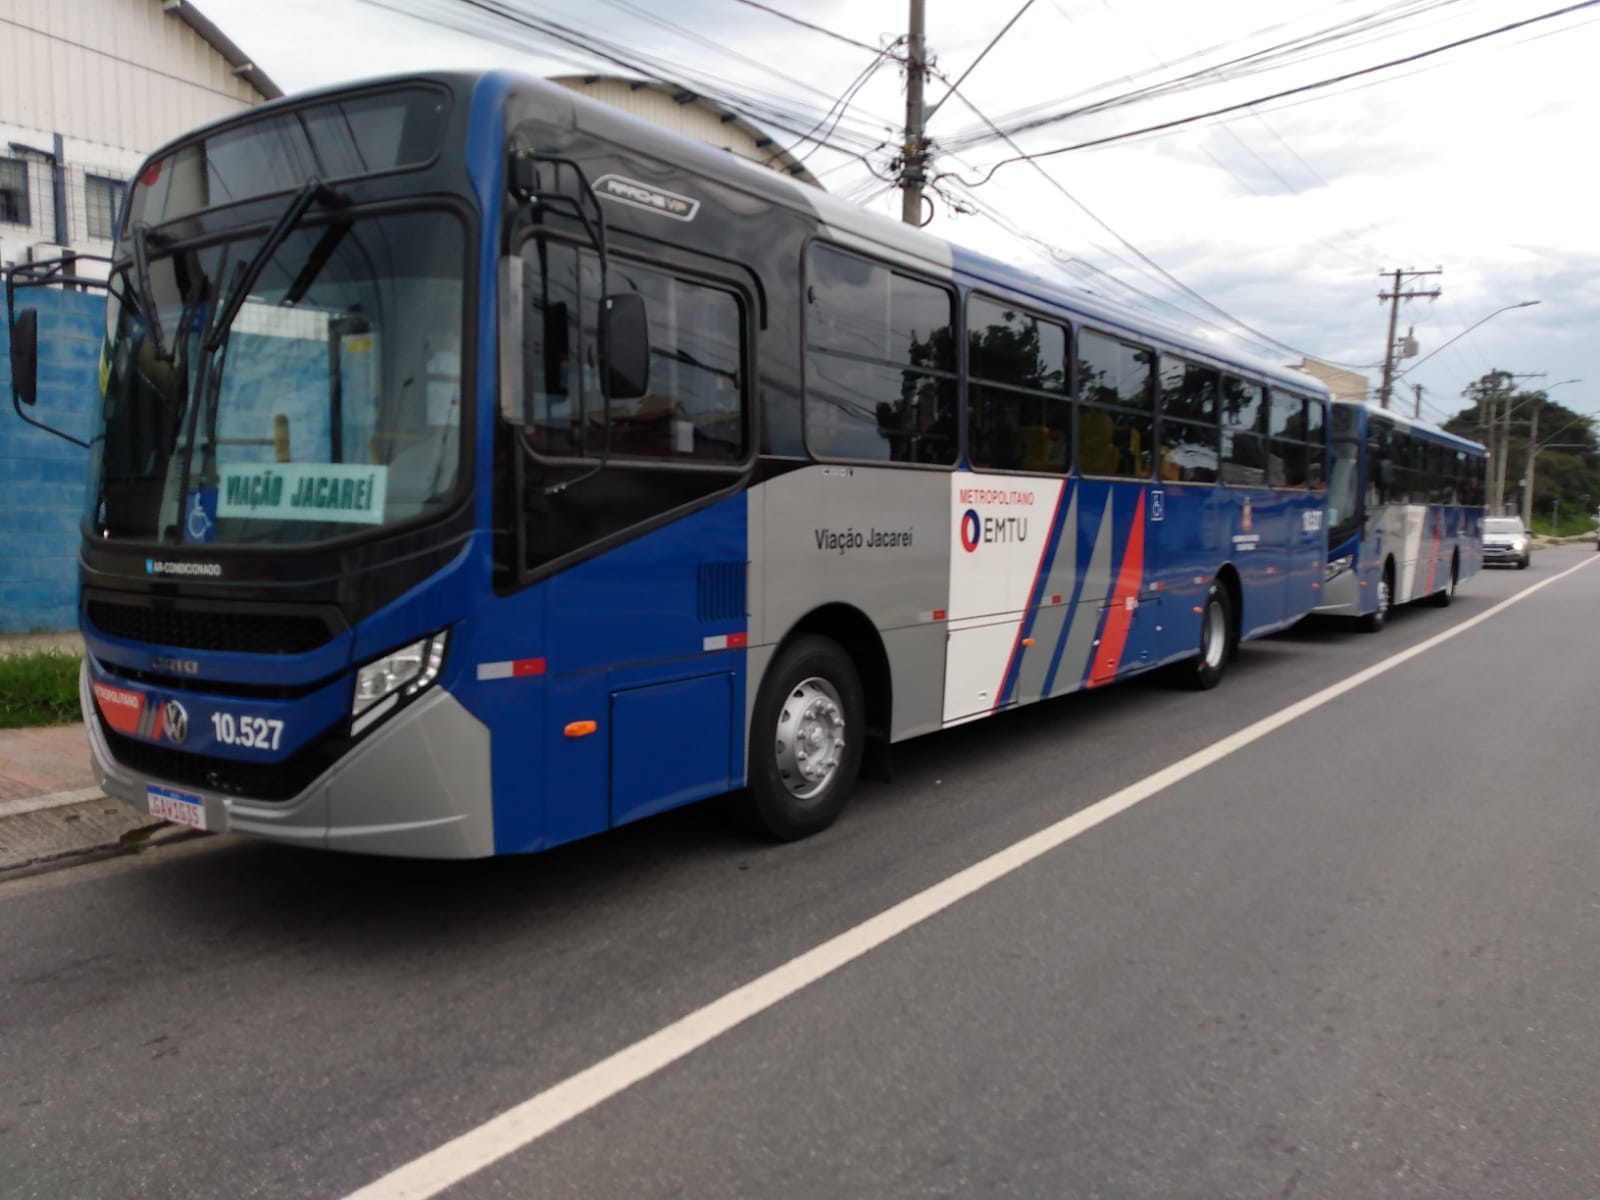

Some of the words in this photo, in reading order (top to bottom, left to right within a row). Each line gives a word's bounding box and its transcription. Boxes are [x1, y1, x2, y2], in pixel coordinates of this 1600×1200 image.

[226, 470, 283, 511] VIAÇÃO
[290, 474, 375, 511] JACAREÍ
[959, 488, 1035, 506] METROPOLITANO
[815, 528, 863, 555] Viação
[983, 517, 1028, 544] EMTU
[211, 711, 285, 751] 10.527
